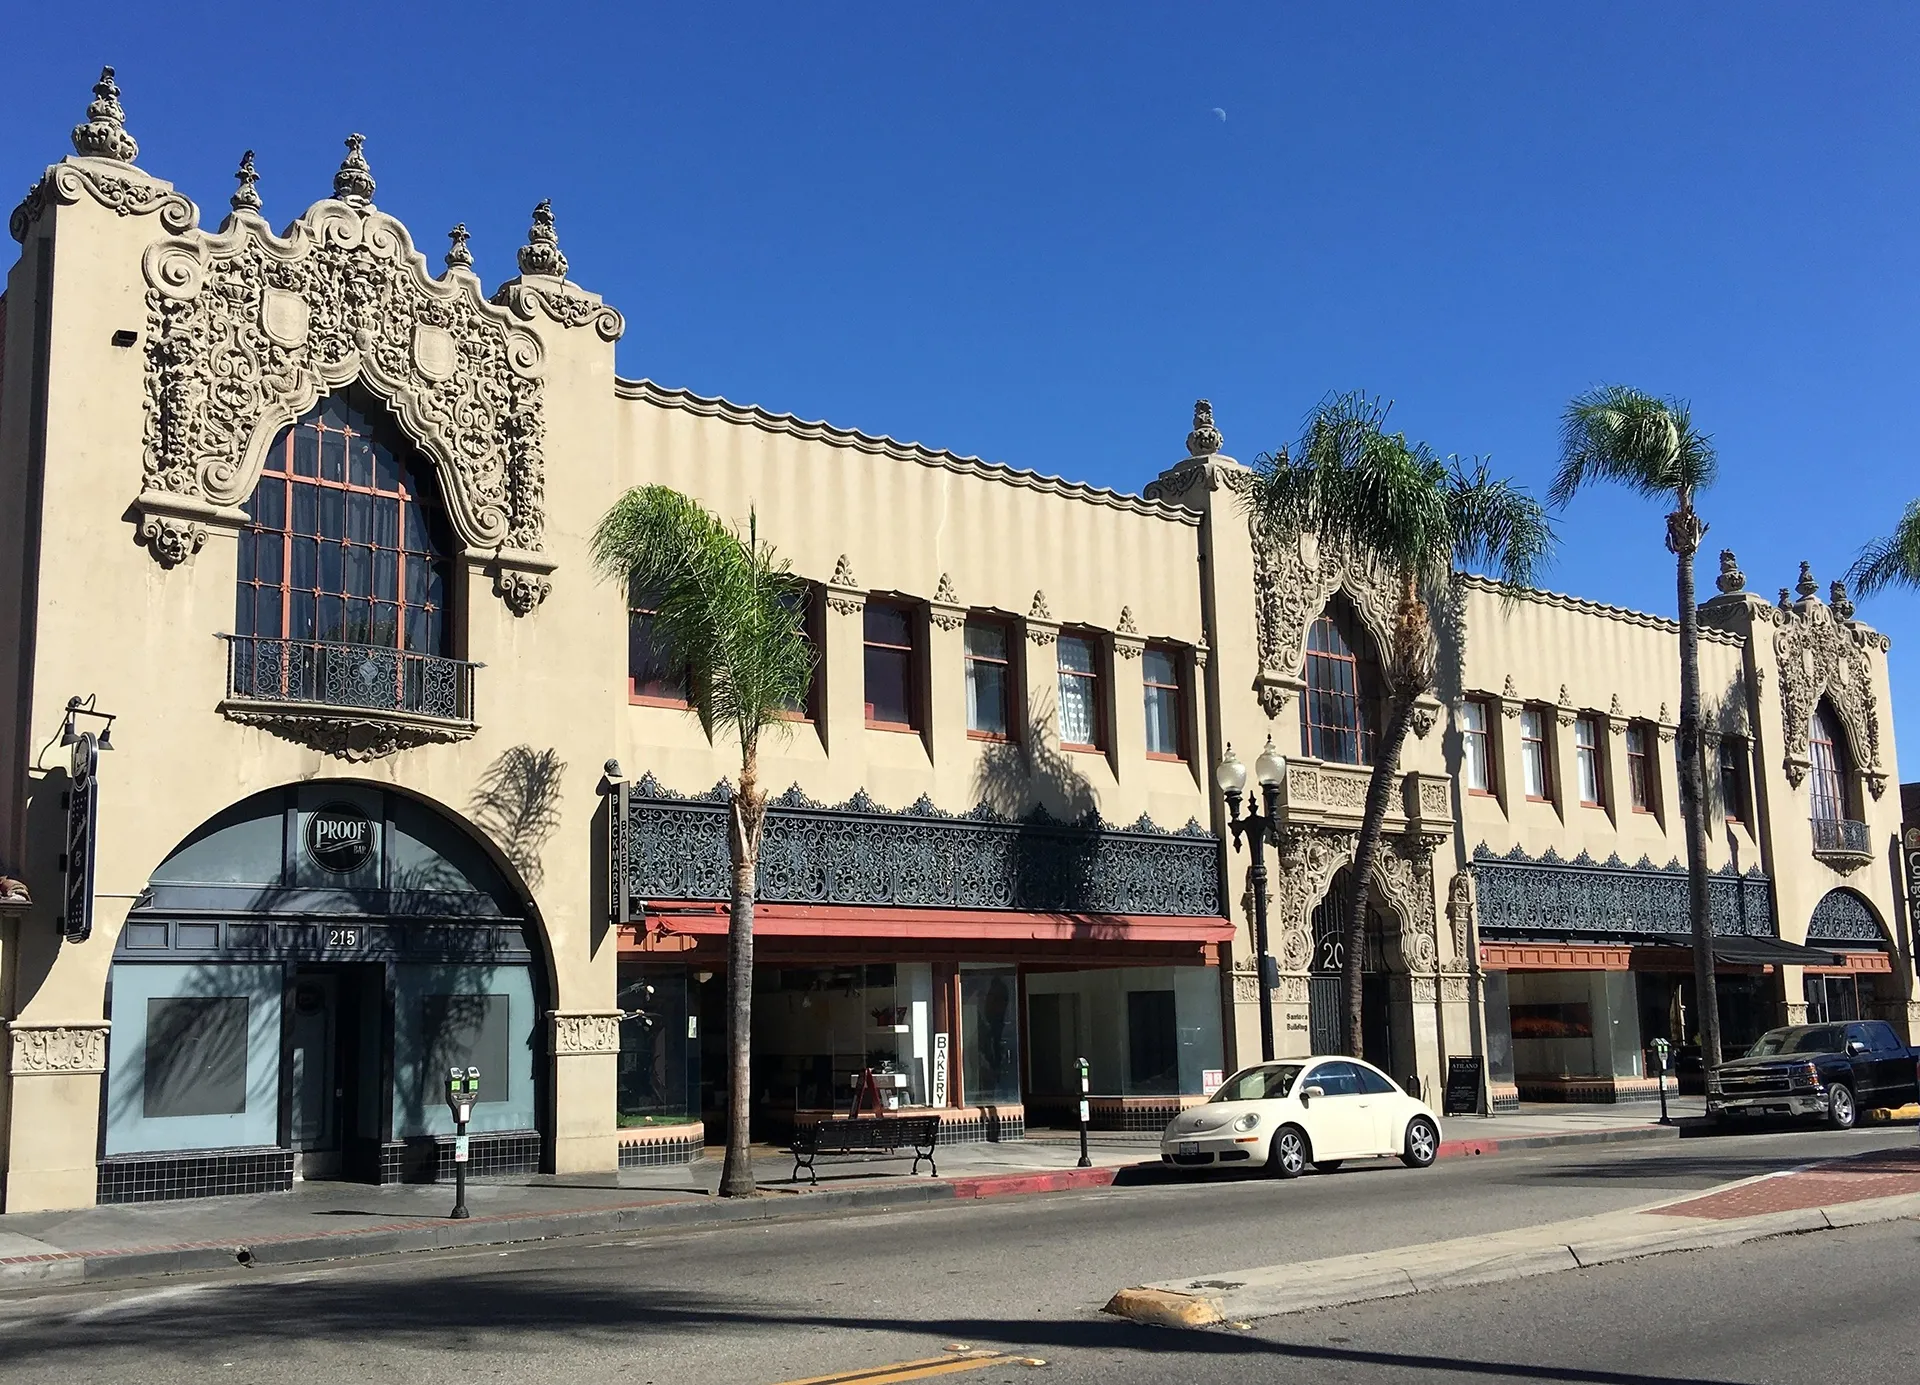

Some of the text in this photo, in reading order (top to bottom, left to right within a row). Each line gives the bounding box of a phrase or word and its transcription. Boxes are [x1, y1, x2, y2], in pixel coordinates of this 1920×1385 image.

[315, 820, 367, 848] PROOF
[330, 930, 356, 946] 215
[1286, 1023, 1308, 1032] Building
[936, 1036, 947, 1104] BAKERY
